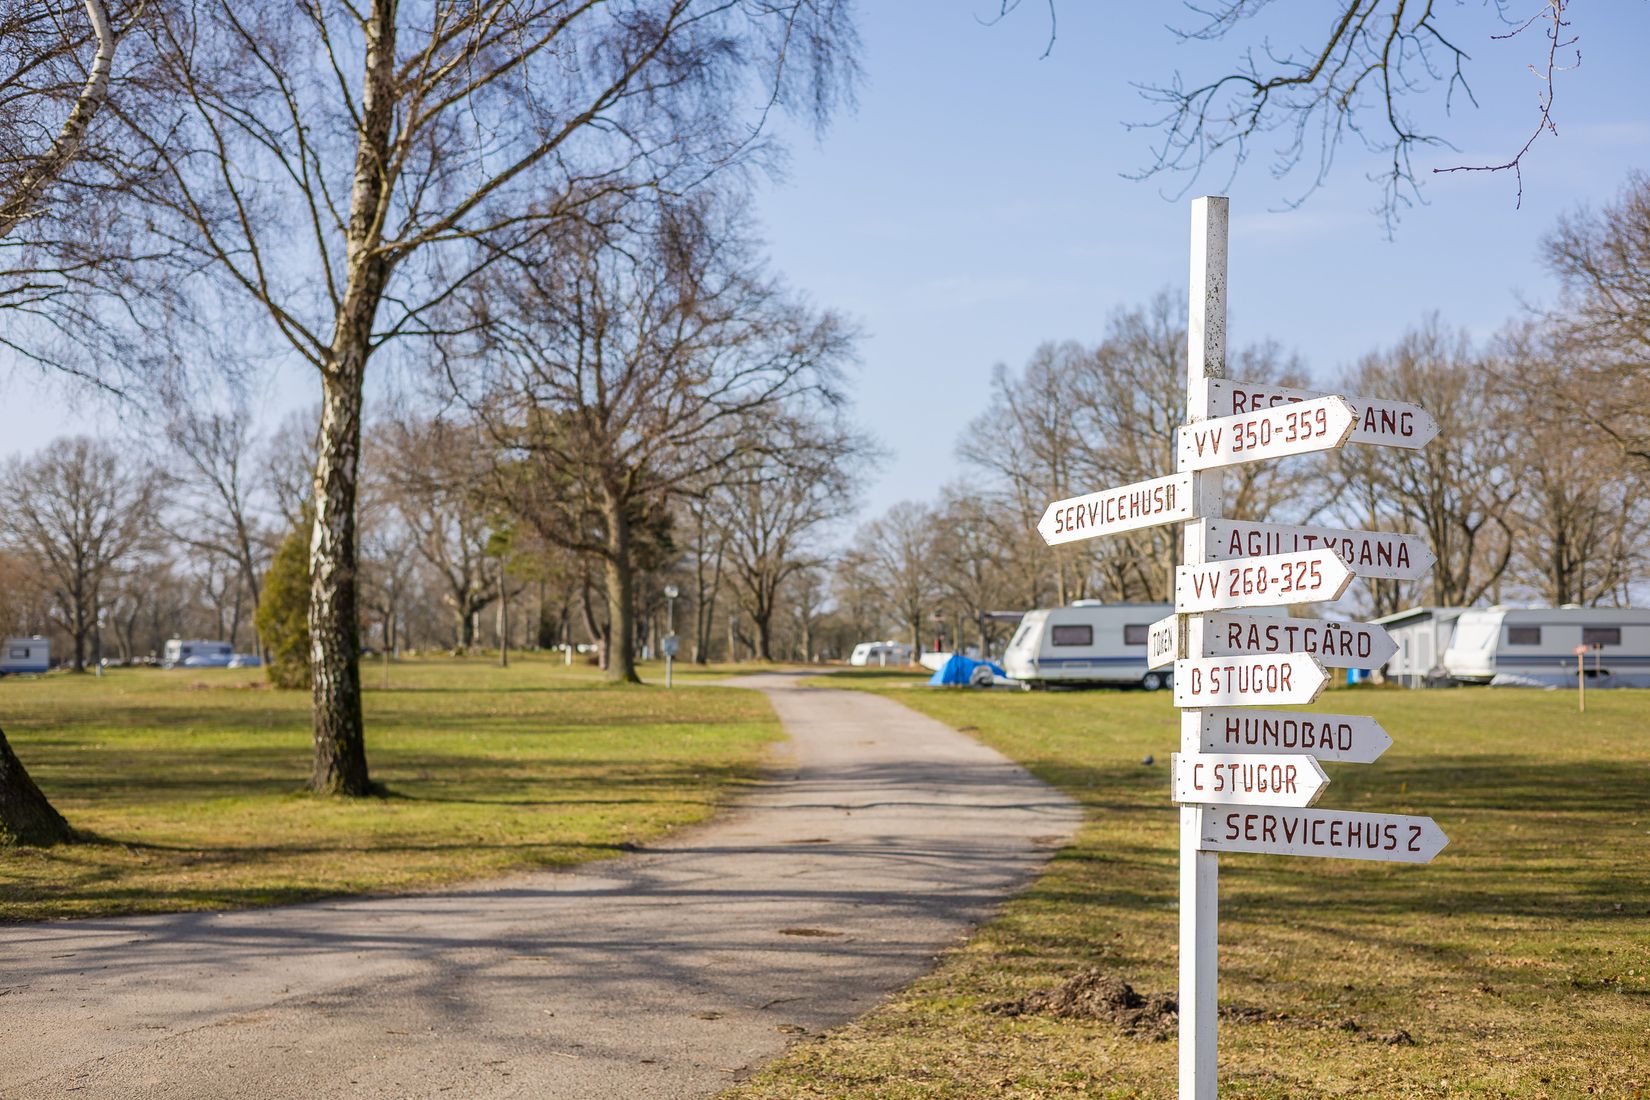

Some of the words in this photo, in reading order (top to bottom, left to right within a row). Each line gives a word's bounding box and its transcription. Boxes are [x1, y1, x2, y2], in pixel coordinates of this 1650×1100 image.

[1194, 427, 1222, 458] VV
[1232, 407, 1327, 453] 350-359
[1229, 529, 1410, 569] AGILITYBANA
[1193, 571, 1221, 600] VV
[1229, 560, 1322, 597] 268-325
[1210, 662, 1292, 695] STUGOR
[1226, 717, 1352, 751] HUNDBAD
[1194, 763, 1204, 791] C
[1214, 763, 1297, 793] STUGOR
[1226, 813, 1397, 850] SERVICEHUS
[1408, 825, 1421, 852] 2
